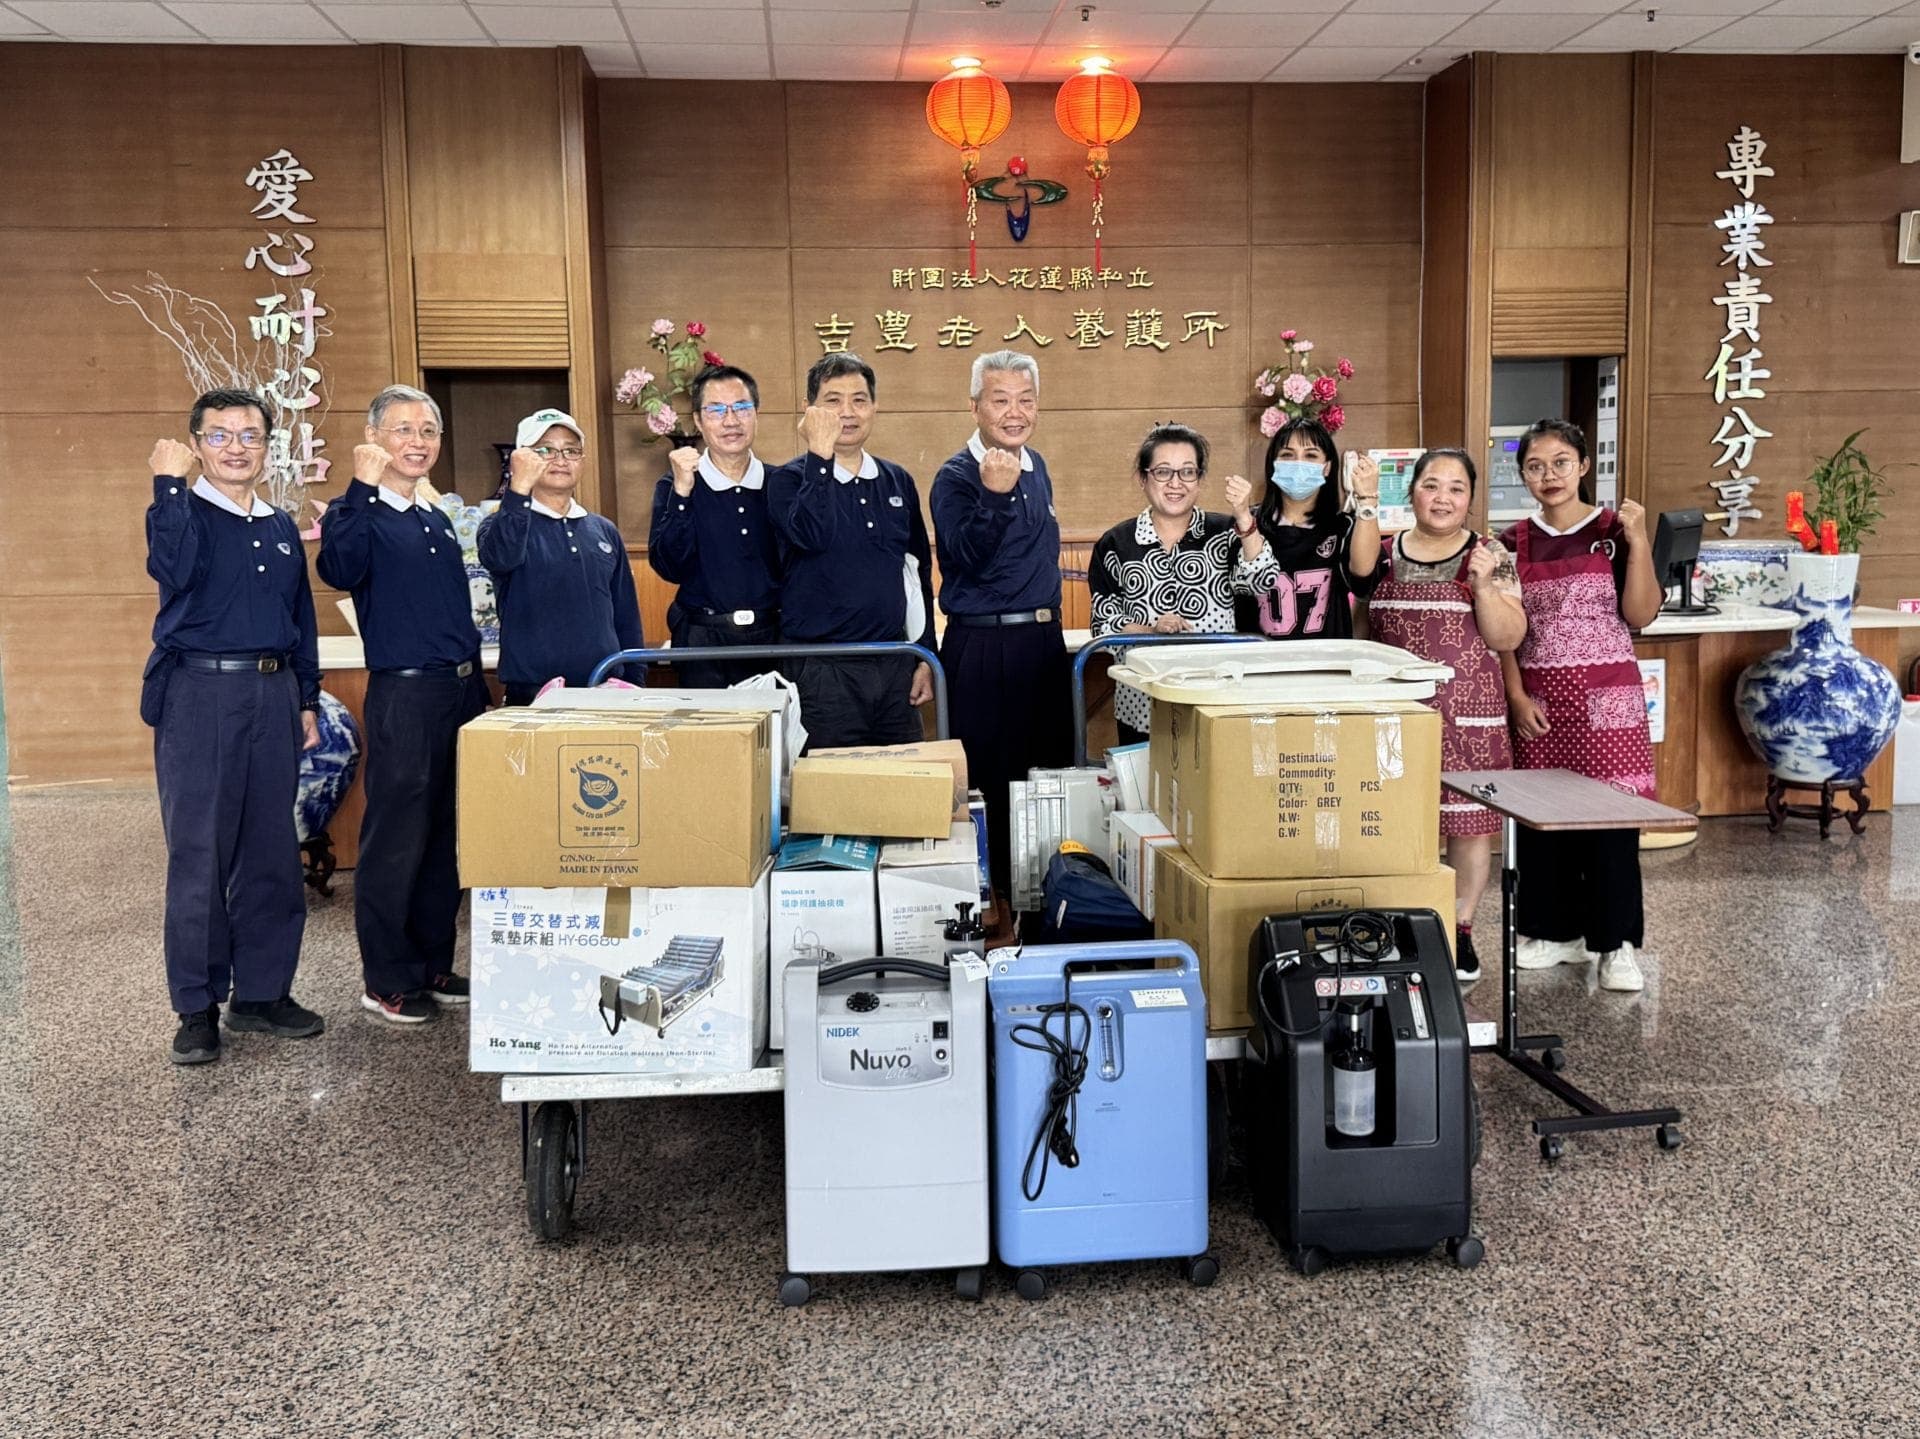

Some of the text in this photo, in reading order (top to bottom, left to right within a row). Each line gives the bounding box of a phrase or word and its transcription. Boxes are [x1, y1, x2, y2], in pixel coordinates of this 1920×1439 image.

[891, 266, 1154, 291] 財團法人花蓮縣私立
[813, 307, 1231, 353] 吉豐老人養護所
[1704, 126, 1776, 537] 專業責任分享
[1258, 568, 1332, 636] 07
[1279, 752, 1336, 763] Destination:
[1279, 767, 1336, 779] Commodity:
[1324, 782, 1335, 793] 10
[1360, 781, 1382, 792] PCS.
[1279, 797, 1341, 808] Color: GREY
[1279, 811, 1382, 823] N.W: KGS.
[1279, 826, 1382, 837] G.W: KGS.
[560, 865, 639, 874] MADE IN TAIWAN
[493, 911, 602, 929] 三管交替式減
[491, 930, 554, 947] 氣墊床組
[826, 1027, 861, 1038] NIDEK
[489, 1038, 542, 1050] Ho Yang
[850, 1049, 912, 1071] Nuvo
